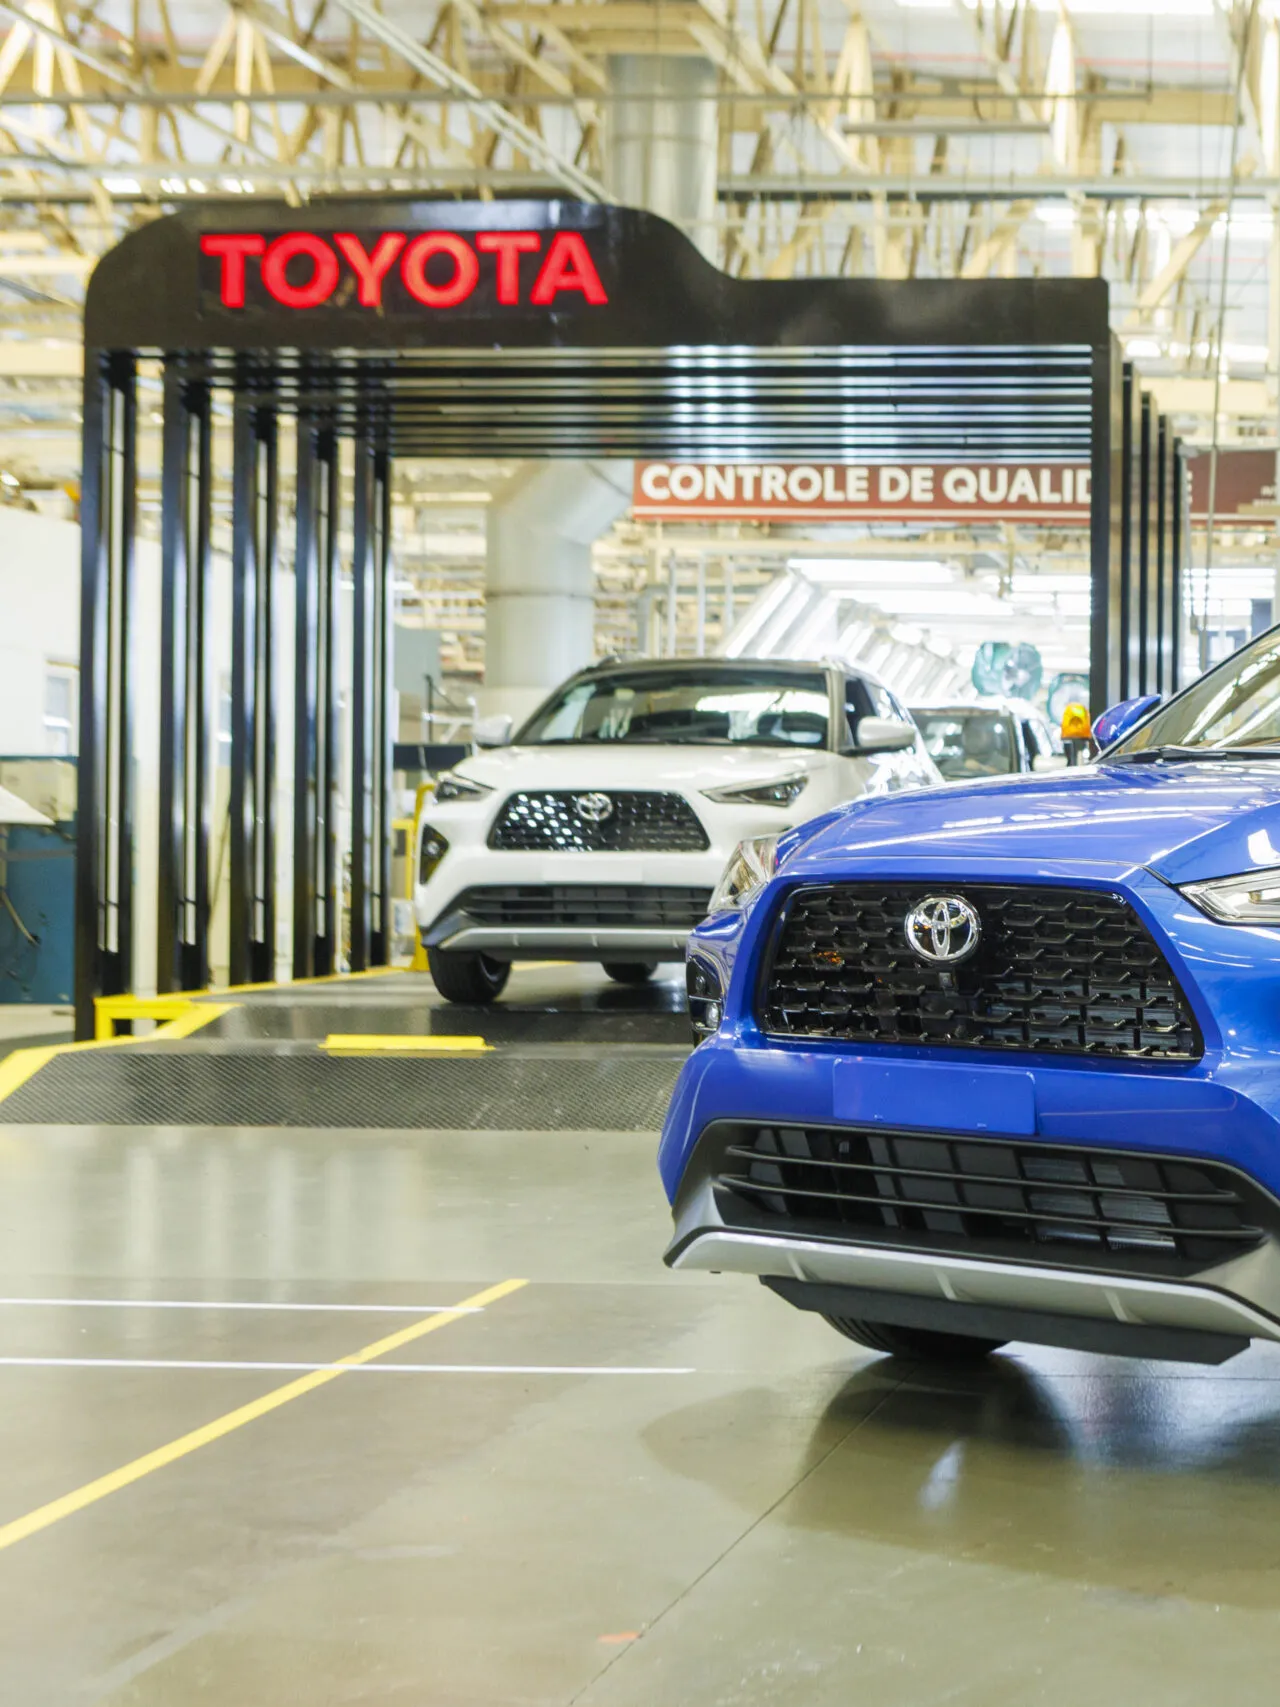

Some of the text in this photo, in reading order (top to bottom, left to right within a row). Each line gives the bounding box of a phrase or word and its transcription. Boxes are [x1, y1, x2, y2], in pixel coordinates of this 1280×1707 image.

[201, 231, 608, 308] TOYOTA
[640, 464, 1193, 504] CONTROLE DE QUALID
